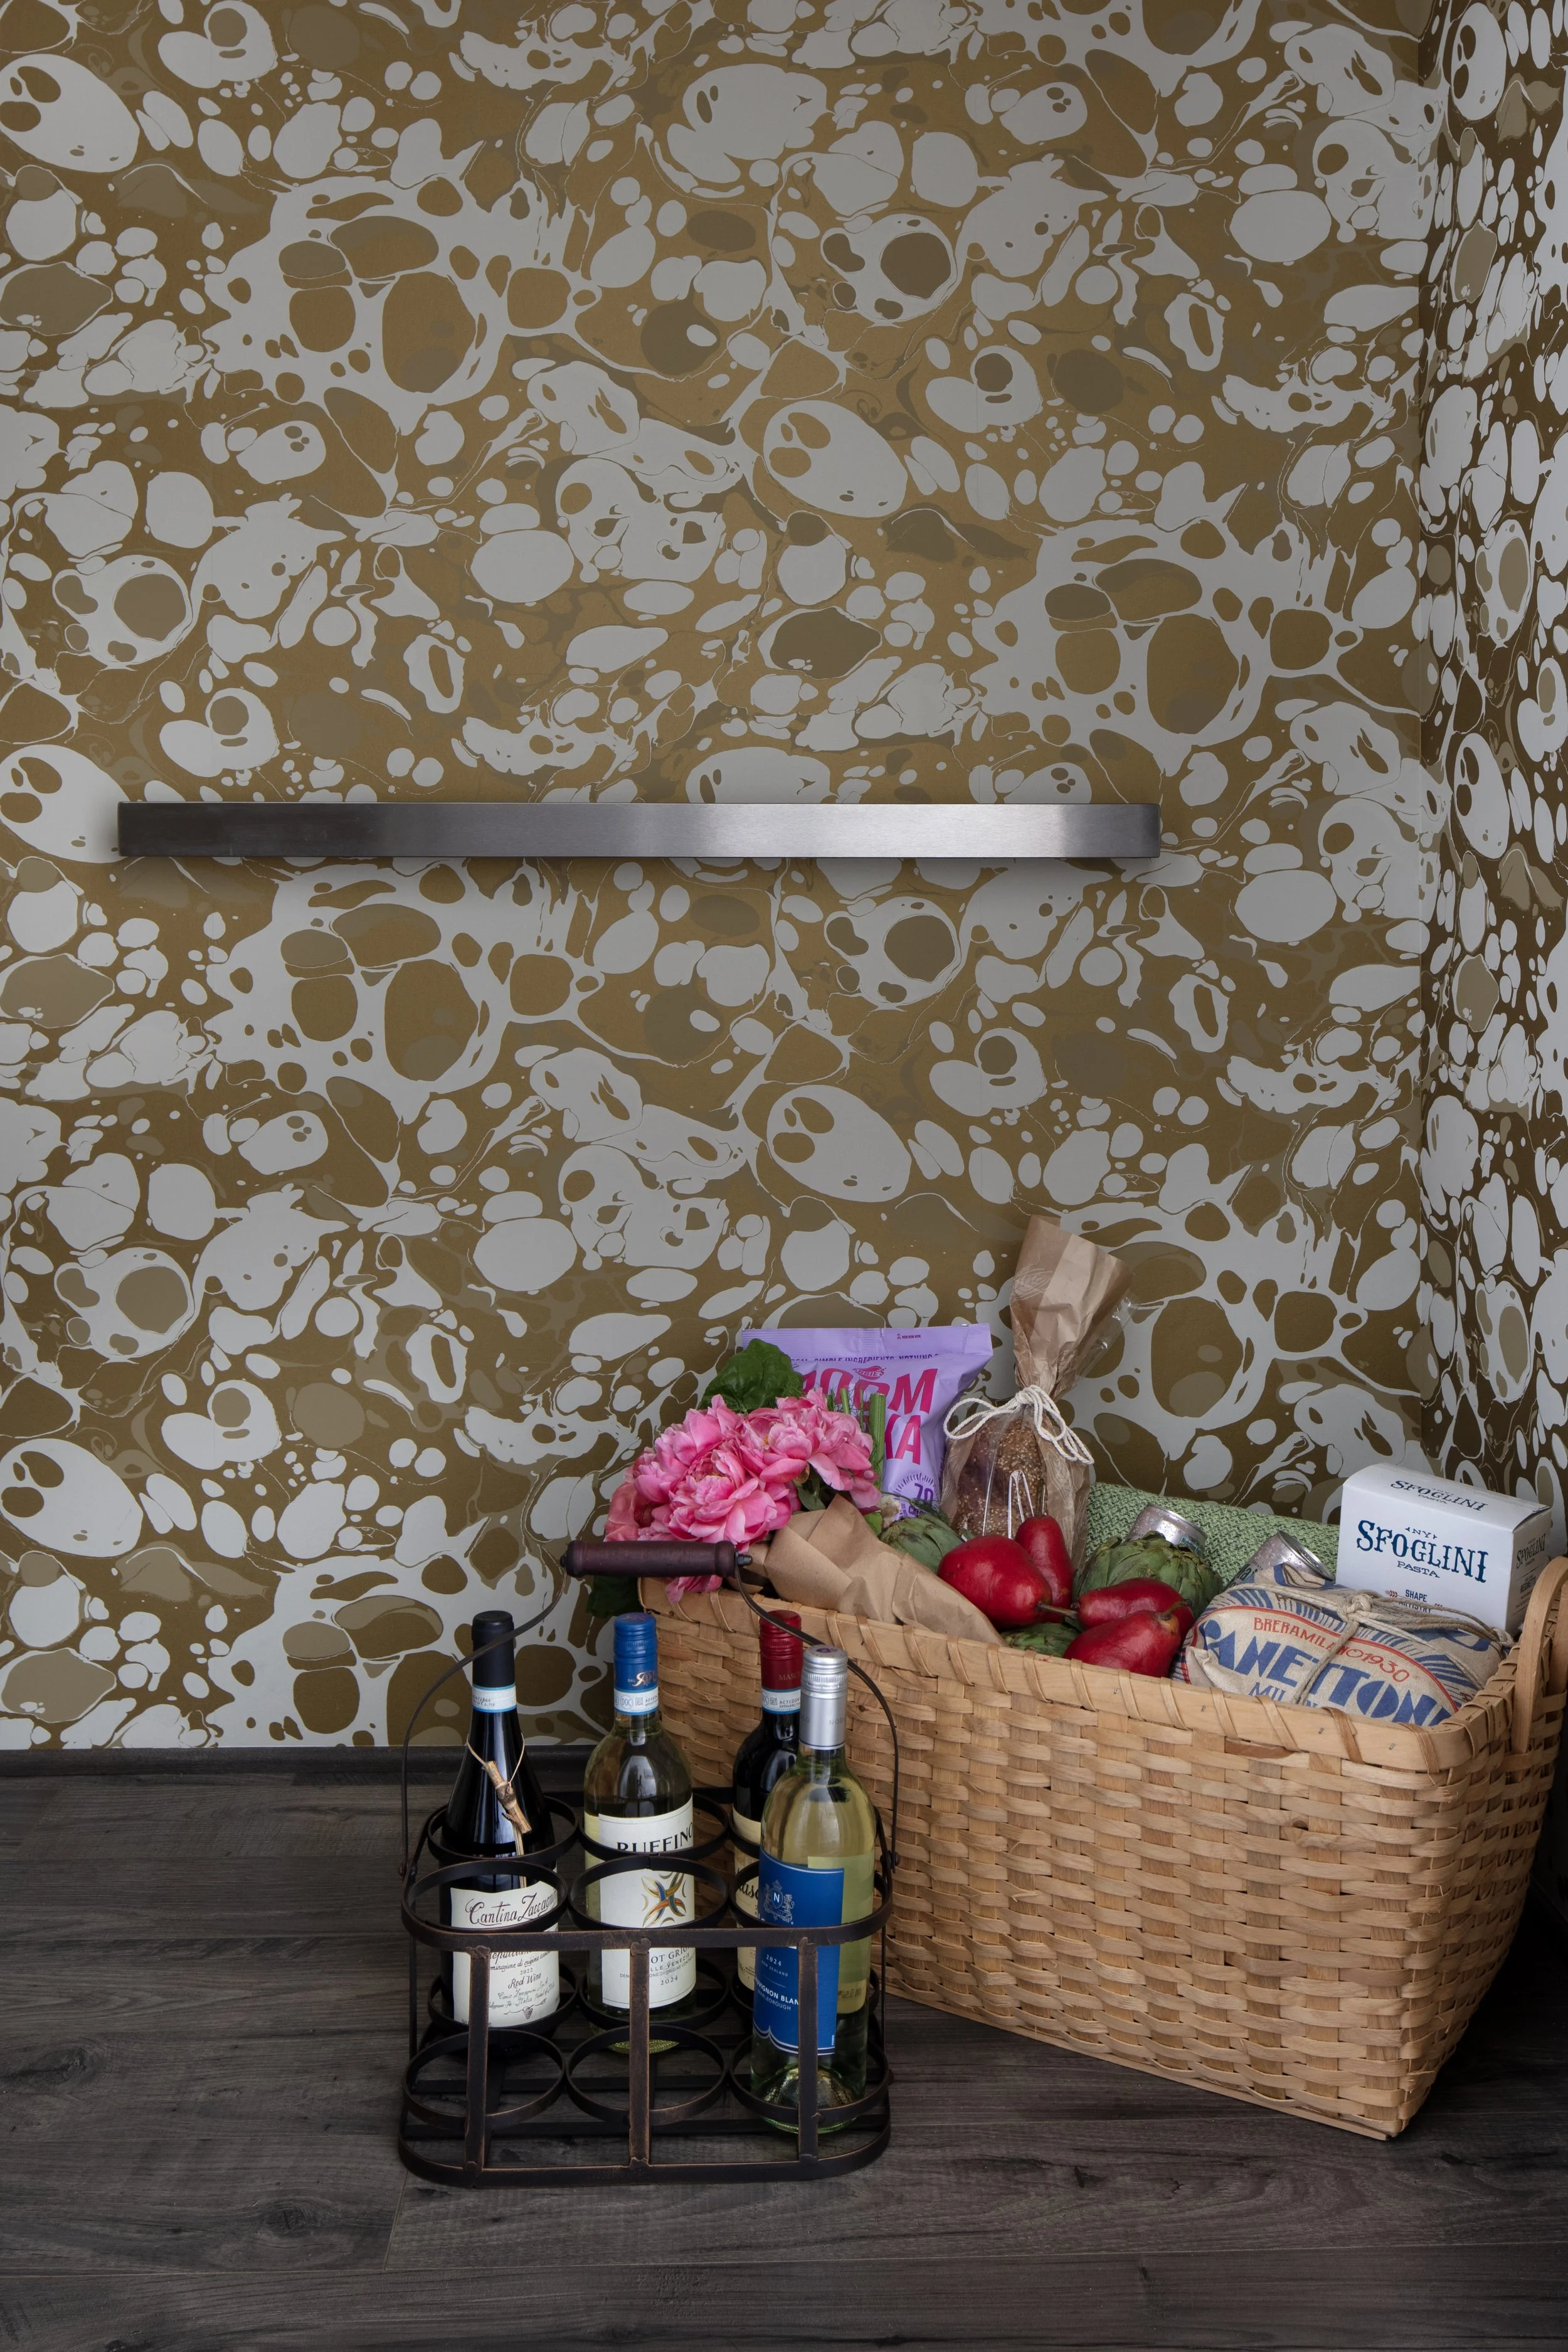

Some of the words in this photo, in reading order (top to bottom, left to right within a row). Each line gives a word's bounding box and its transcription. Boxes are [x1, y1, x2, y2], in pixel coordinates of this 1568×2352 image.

[803, 1368, 938, 1415] OOM
[1390, 1480, 1488, 1512] SFOGLINI
[1417, 1493, 1448, 1504] PASTA
[1356, 1520, 1489, 1583] SFOGLINI
[1516, 1534, 1546, 1569] SFOGLINI
[1397, 1560, 1441, 1579] PASTA
[1406, 1589, 1428, 1602] SHAPE
[1199, 1619, 1453, 1727] PANETTON
[622, 1697, 632, 1706] DOC
[617, 1821, 693, 1853] RUFFINO
[773, 1892, 780, 1903] N
[465, 1898, 518, 1926] Cantina
[517, 1959, 524, 1968] di
[524, 1955, 539, 1968] origine
[667, 1952, 690, 1968] VENEZIE
[766, 1954, 782, 1967] 2024
[520, 1968, 534, 1976] 2022
[769, 1965, 789, 1978] ZEALAND
[508, 1976, 525, 1989] Red
[526, 1973, 542, 1984] Wine
[660, 1975, 679, 1986] 2024
[757, 1988, 792, 2011] MARLBOROUGH
[781, 1995, 799, 2006] BLAN
